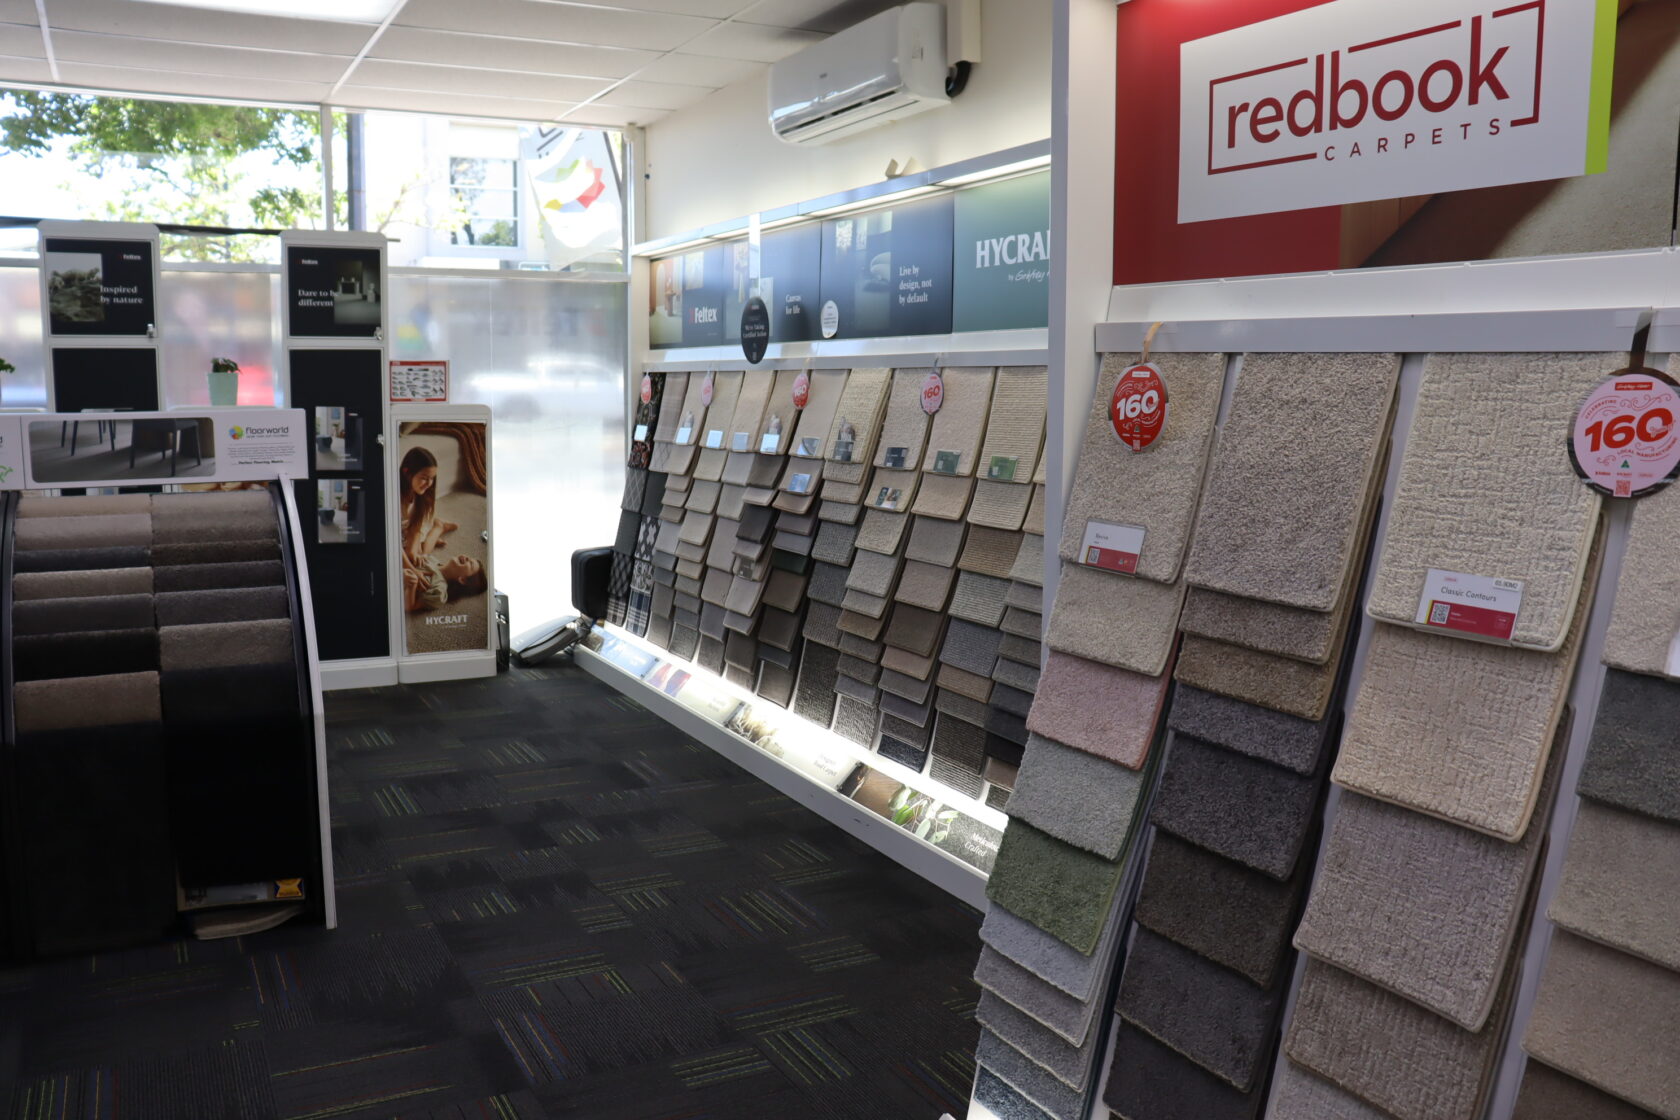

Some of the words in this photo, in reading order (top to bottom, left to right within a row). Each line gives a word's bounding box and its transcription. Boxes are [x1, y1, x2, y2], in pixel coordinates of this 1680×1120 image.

[1227, 16, 1511, 149] redbook
[1324, 118, 1501, 162] CARPETS
[899, 266, 911, 277] Live
[912, 265, 920, 277] by
[100, 285, 138, 295] Inspired
[898, 280, 921, 292] design,
[922, 278, 932, 289] not
[100, 296, 111, 305] by
[298, 289, 318, 297] Dare
[898, 293, 906, 306] by
[906, 291, 929, 304] default
[297, 298, 334, 307] different
[694, 306, 718, 324] Feltex
[794, 383, 807, 398] 160
[923, 384, 941, 400] 160
[1116, 389, 1160, 421] 160
[1585, 399, 1617, 419] CELEBRATING
[245, 426, 290, 435] floorworld
[1584, 407, 1674, 453] 160
[1616, 448, 1635, 456] LOCAL
[1440, 585, 1464, 597] Classic
[1465, 590, 1497, 602] Contours
[425, 614, 468, 625] HYCRAFT
